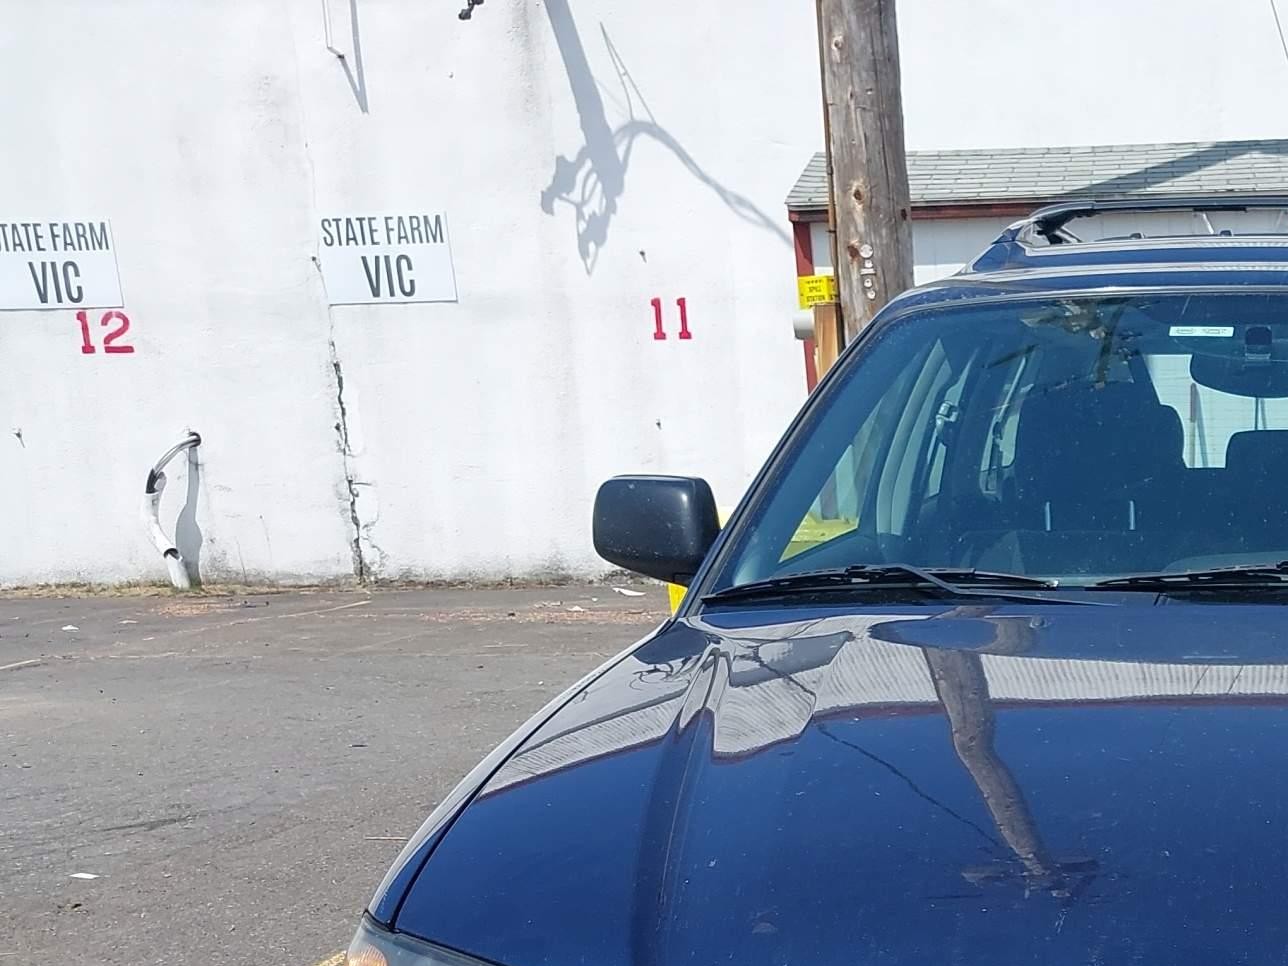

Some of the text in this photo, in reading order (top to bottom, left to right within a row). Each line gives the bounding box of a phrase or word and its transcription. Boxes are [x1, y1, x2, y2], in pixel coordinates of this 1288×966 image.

[0, 222, 110, 252] TATE FARM
[321, 214, 445, 247] STATE FARM
[28, 261, 84, 304] VIC
[361, 254, 416, 298] VIC
[76, 311, 135, 354] 12
[650, 297, 693, 340] 11
